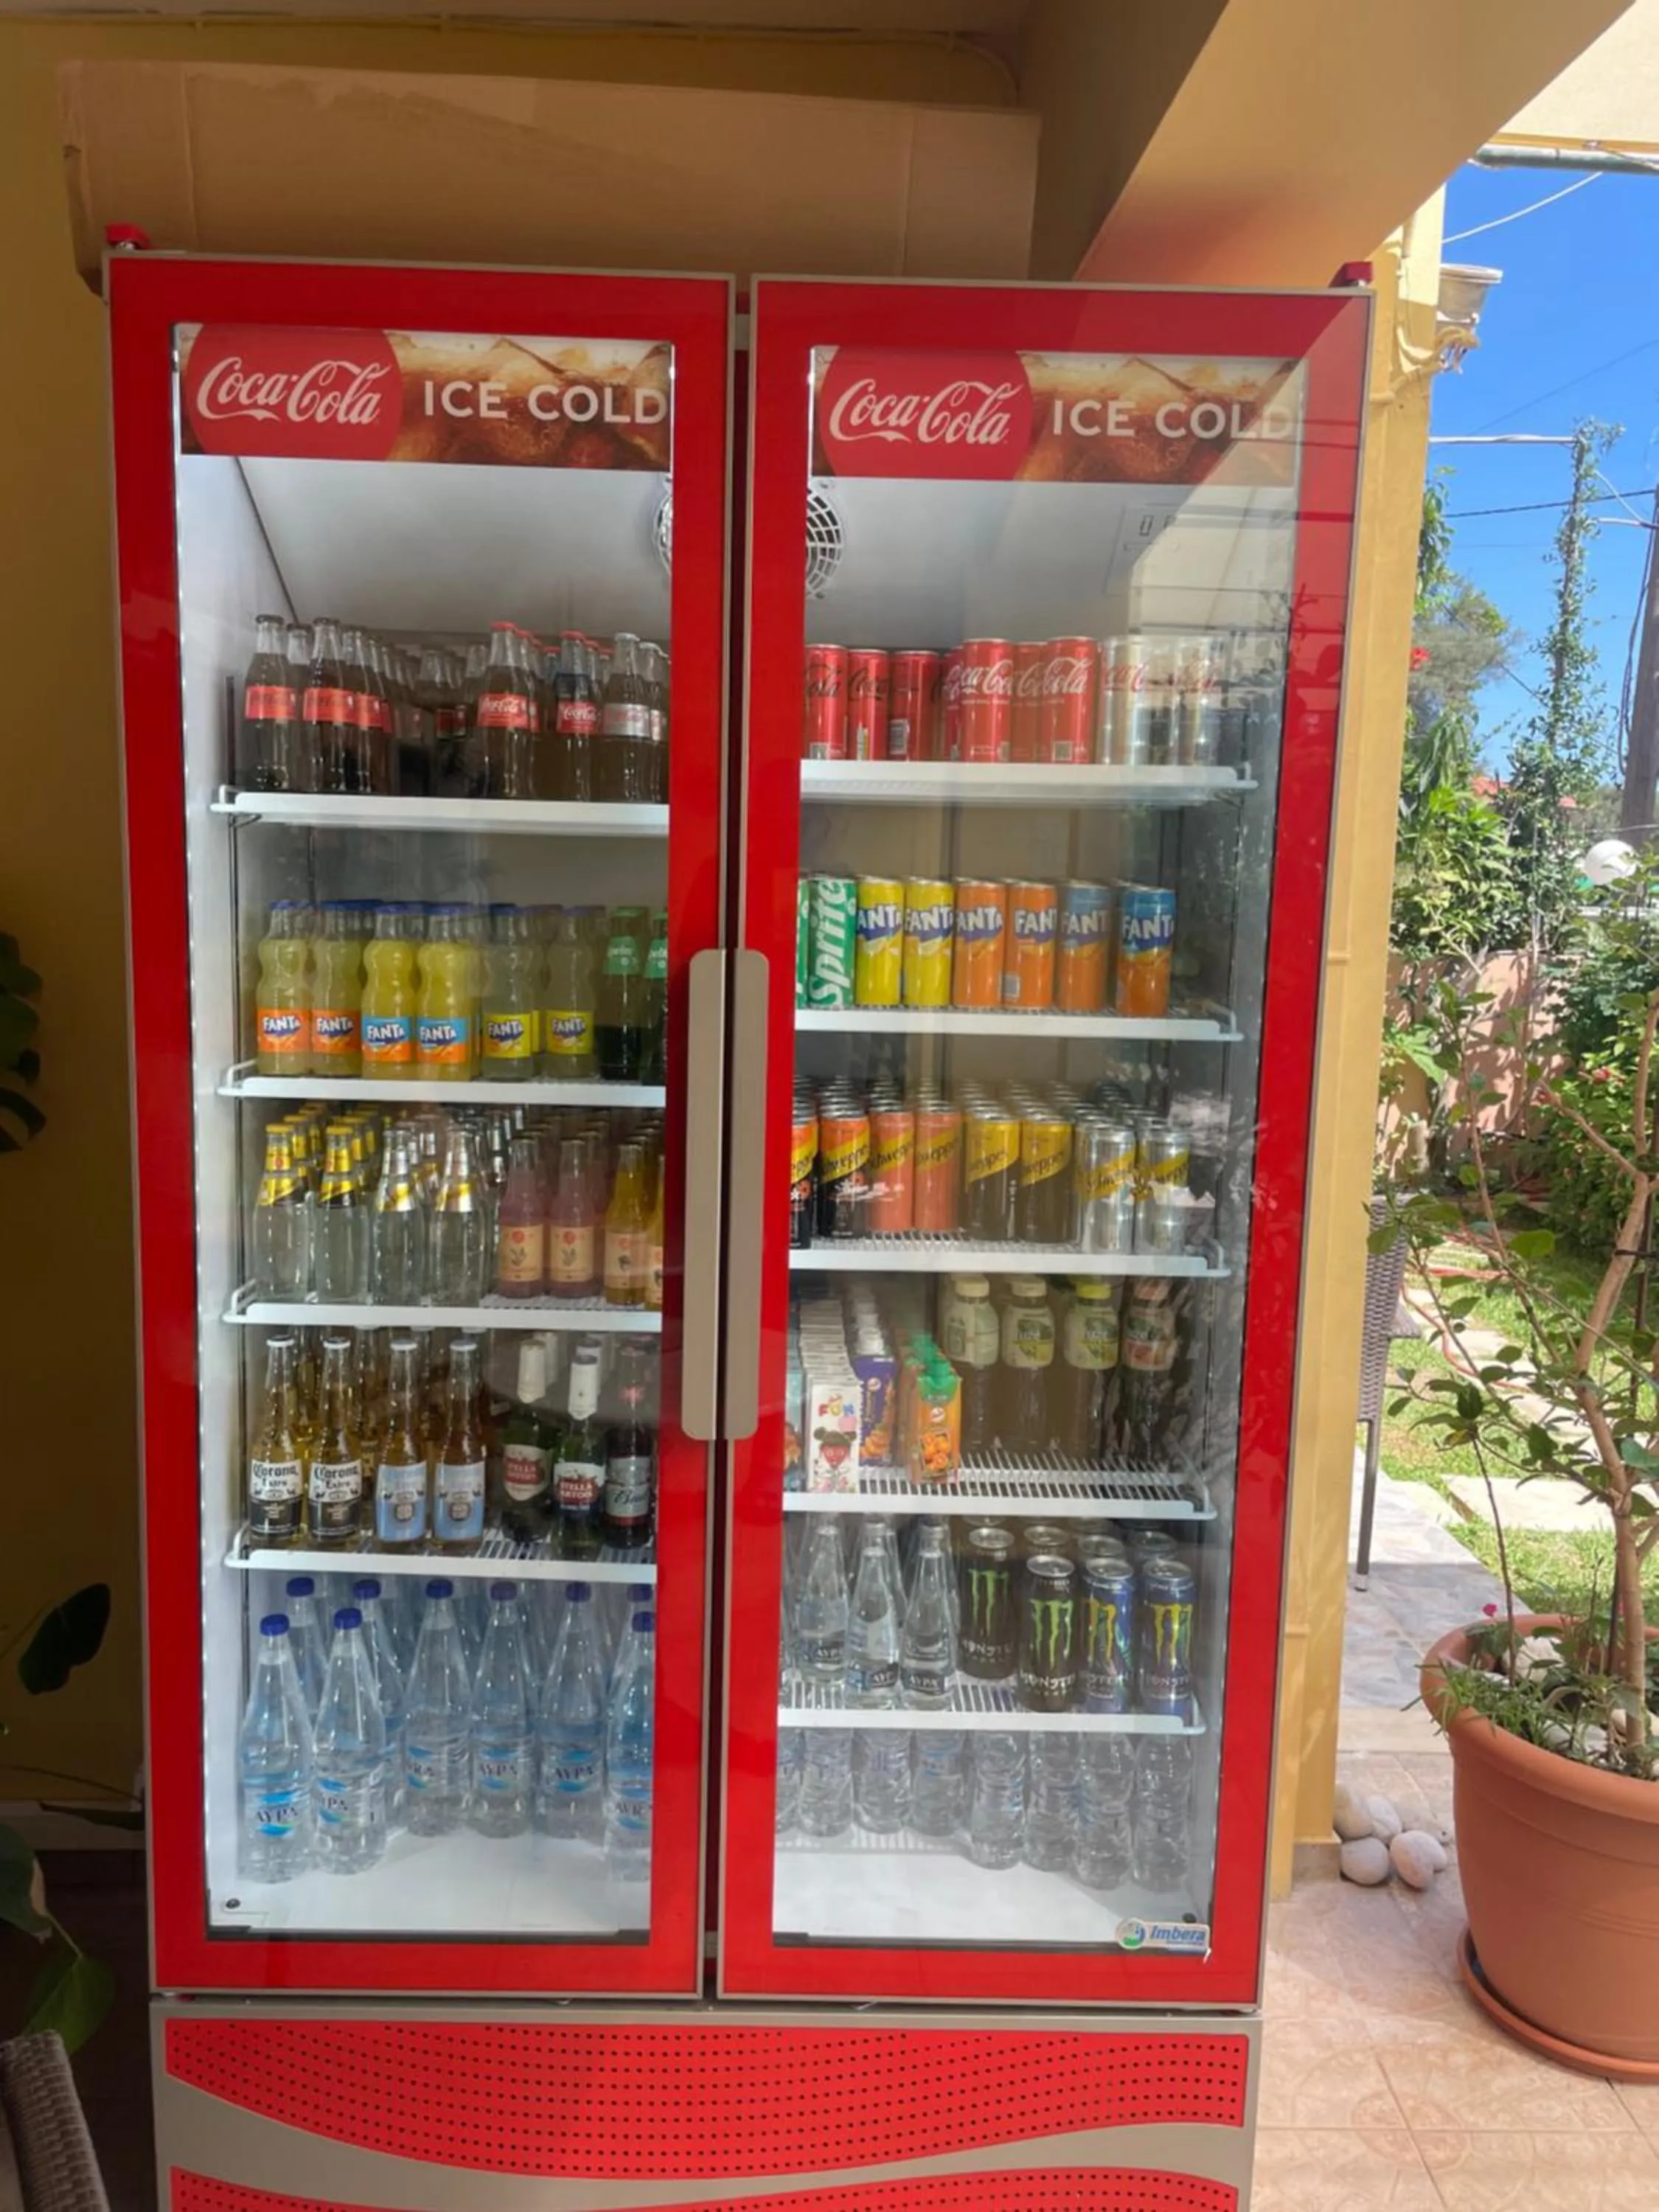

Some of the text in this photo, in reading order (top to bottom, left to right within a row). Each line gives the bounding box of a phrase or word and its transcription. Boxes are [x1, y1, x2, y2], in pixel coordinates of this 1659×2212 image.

[197, 356, 391, 425] Coca-Cola
[425, 380, 665, 424] ICE COLD
[830, 378, 1023, 445] Coca-Cola
[1054, 400, 1293, 439] ICE COLD
[858, 905, 902, 931] ANT
[956, 906, 1004, 932] ANTA
[1015, 908, 1057, 935] FAN
[1062, 910, 1109, 935] FANT
[810, 873, 850, 1010] Sprite
[366, 1023, 405, 1041] FANTA
[419, 1025, 457, 1042] FANTA
[253, 1464, 299, 1479] Corona
[314, 1465, 359, 1481] Corona
[1150, 1924, 1206, 1942] Imbera
